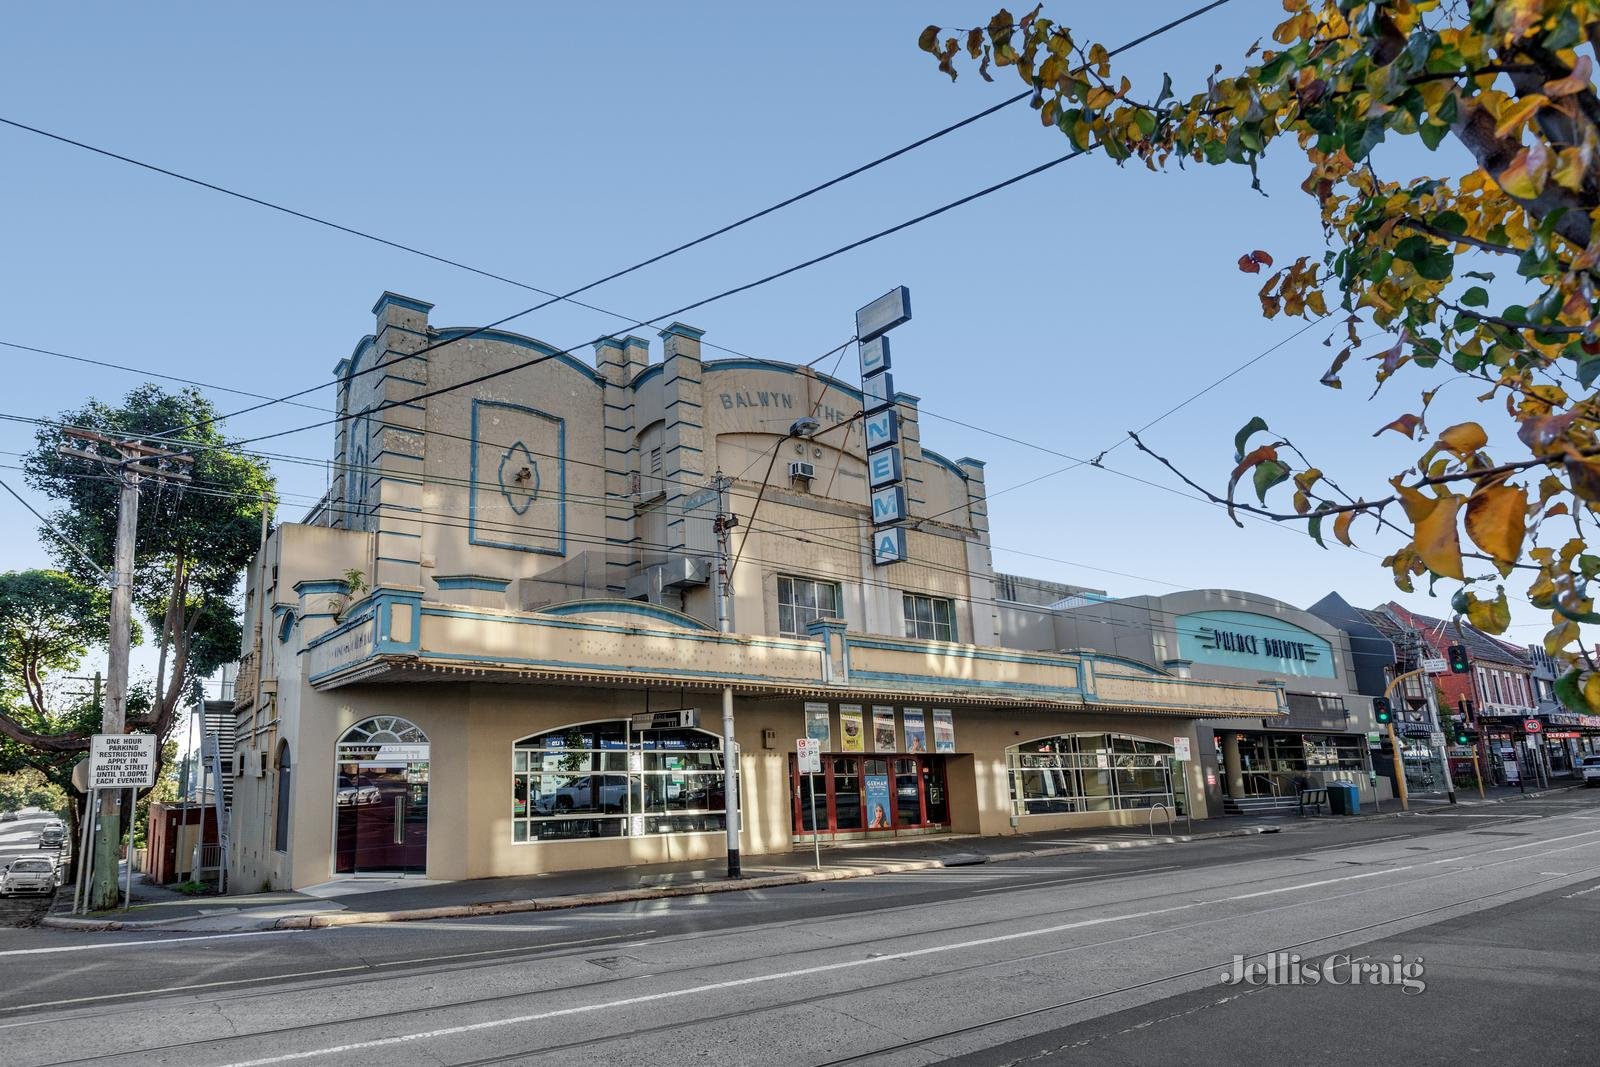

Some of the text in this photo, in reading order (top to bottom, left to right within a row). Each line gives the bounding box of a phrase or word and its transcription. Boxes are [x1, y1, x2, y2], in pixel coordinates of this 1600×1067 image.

[720, 391, 792, 409] BALWYN
[863, 345, 897, 557] CINEMA
[1214, 629, 1258, 655] PALACE
[1527, 722, 1538, 730] 40
